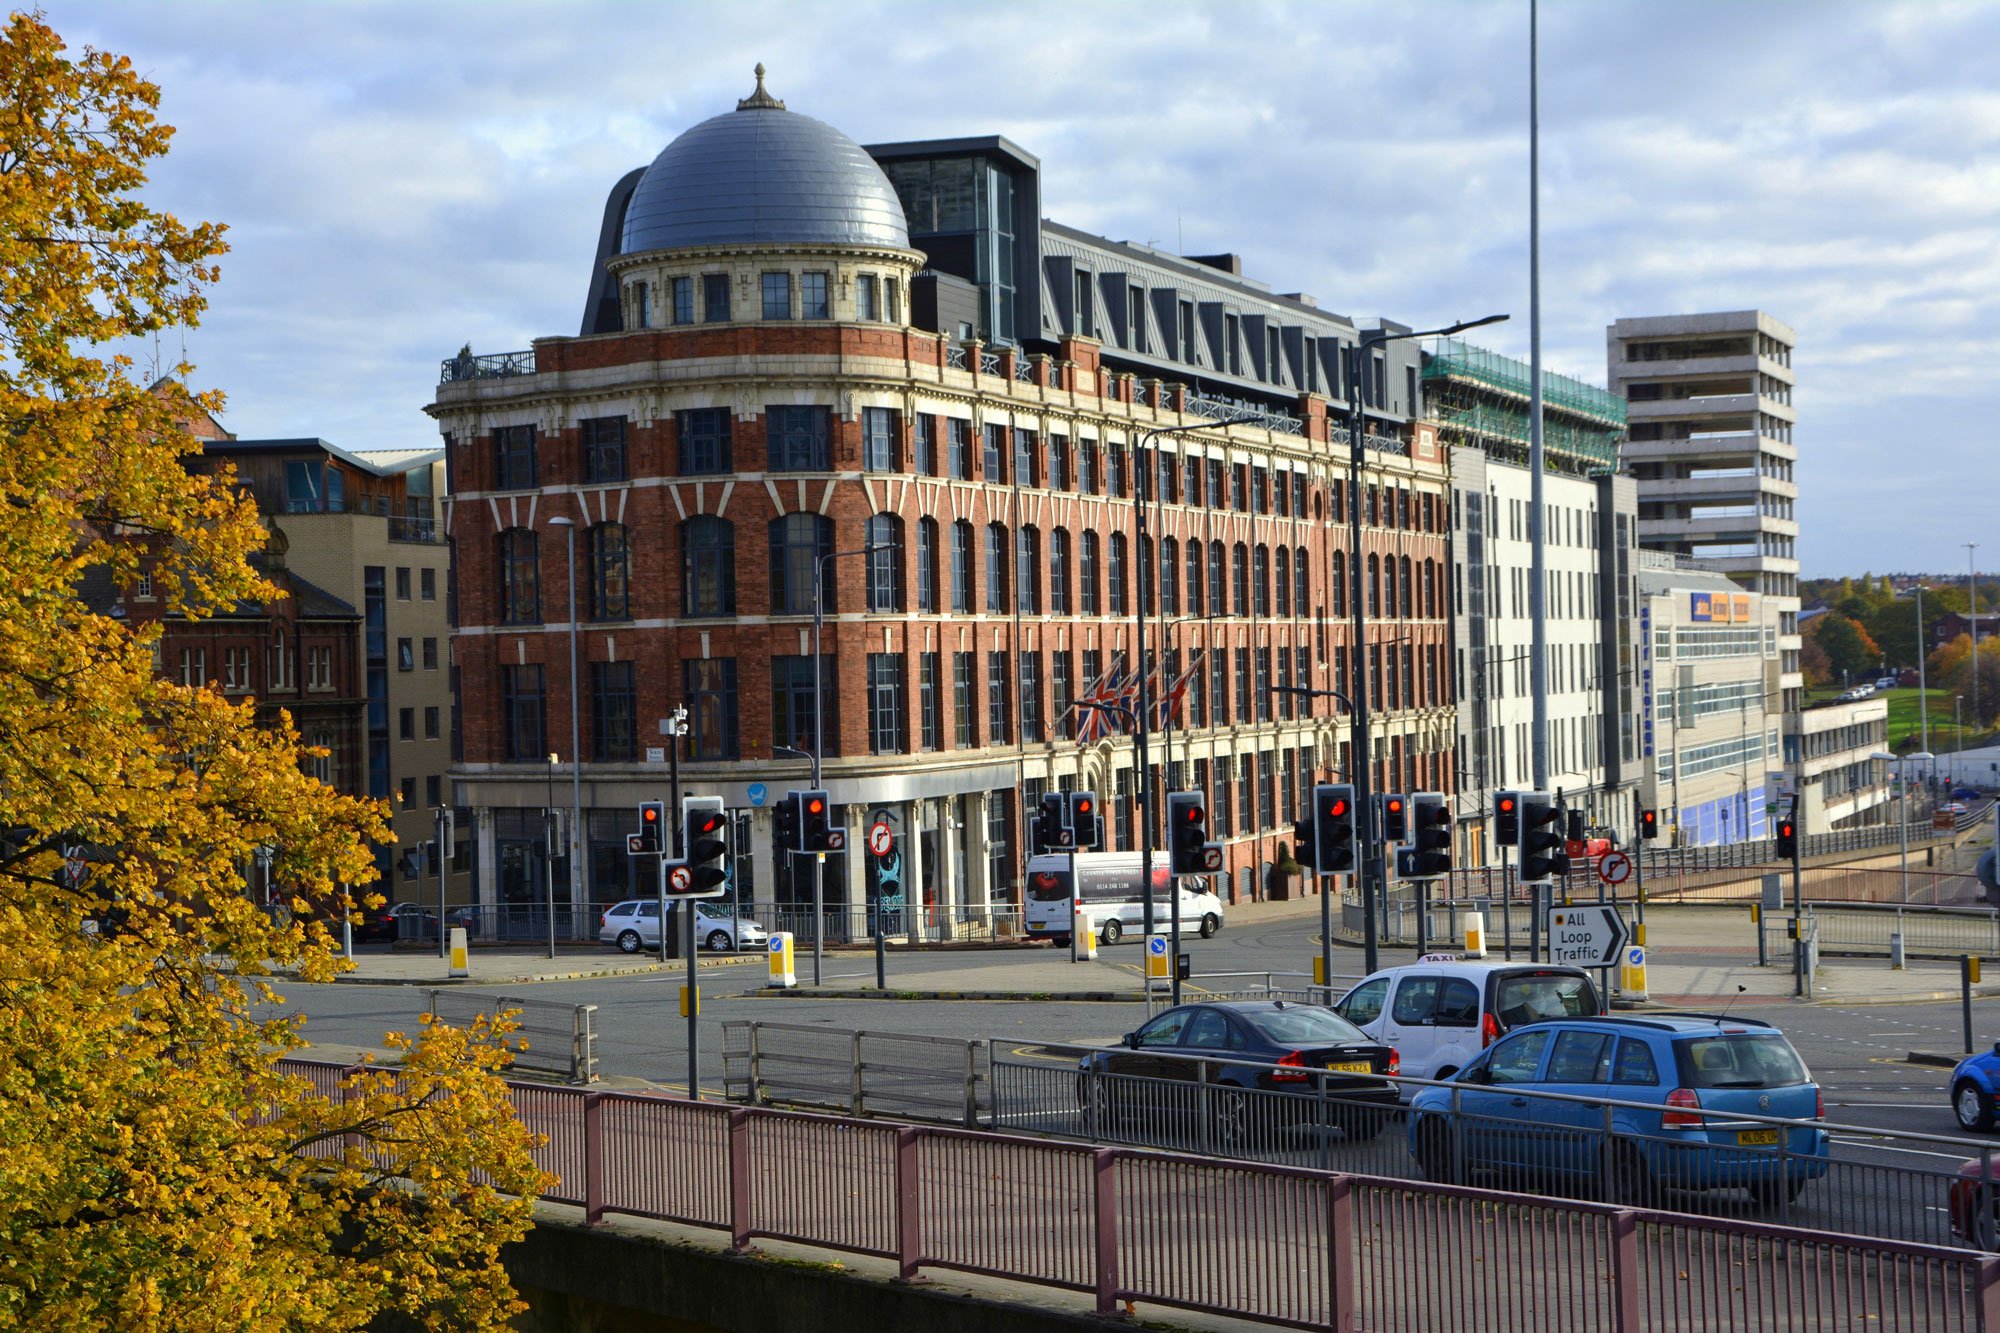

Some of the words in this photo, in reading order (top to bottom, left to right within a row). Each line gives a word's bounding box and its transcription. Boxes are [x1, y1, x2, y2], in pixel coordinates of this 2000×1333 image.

[1641, 608, 1649, 660] self
[1643, 669, 1653, 756] storage
[1567, 913, 1585, 926] All
[1561, 931, 1592, 944] Loop
[1555, 946, 1599, 960] Traffic
